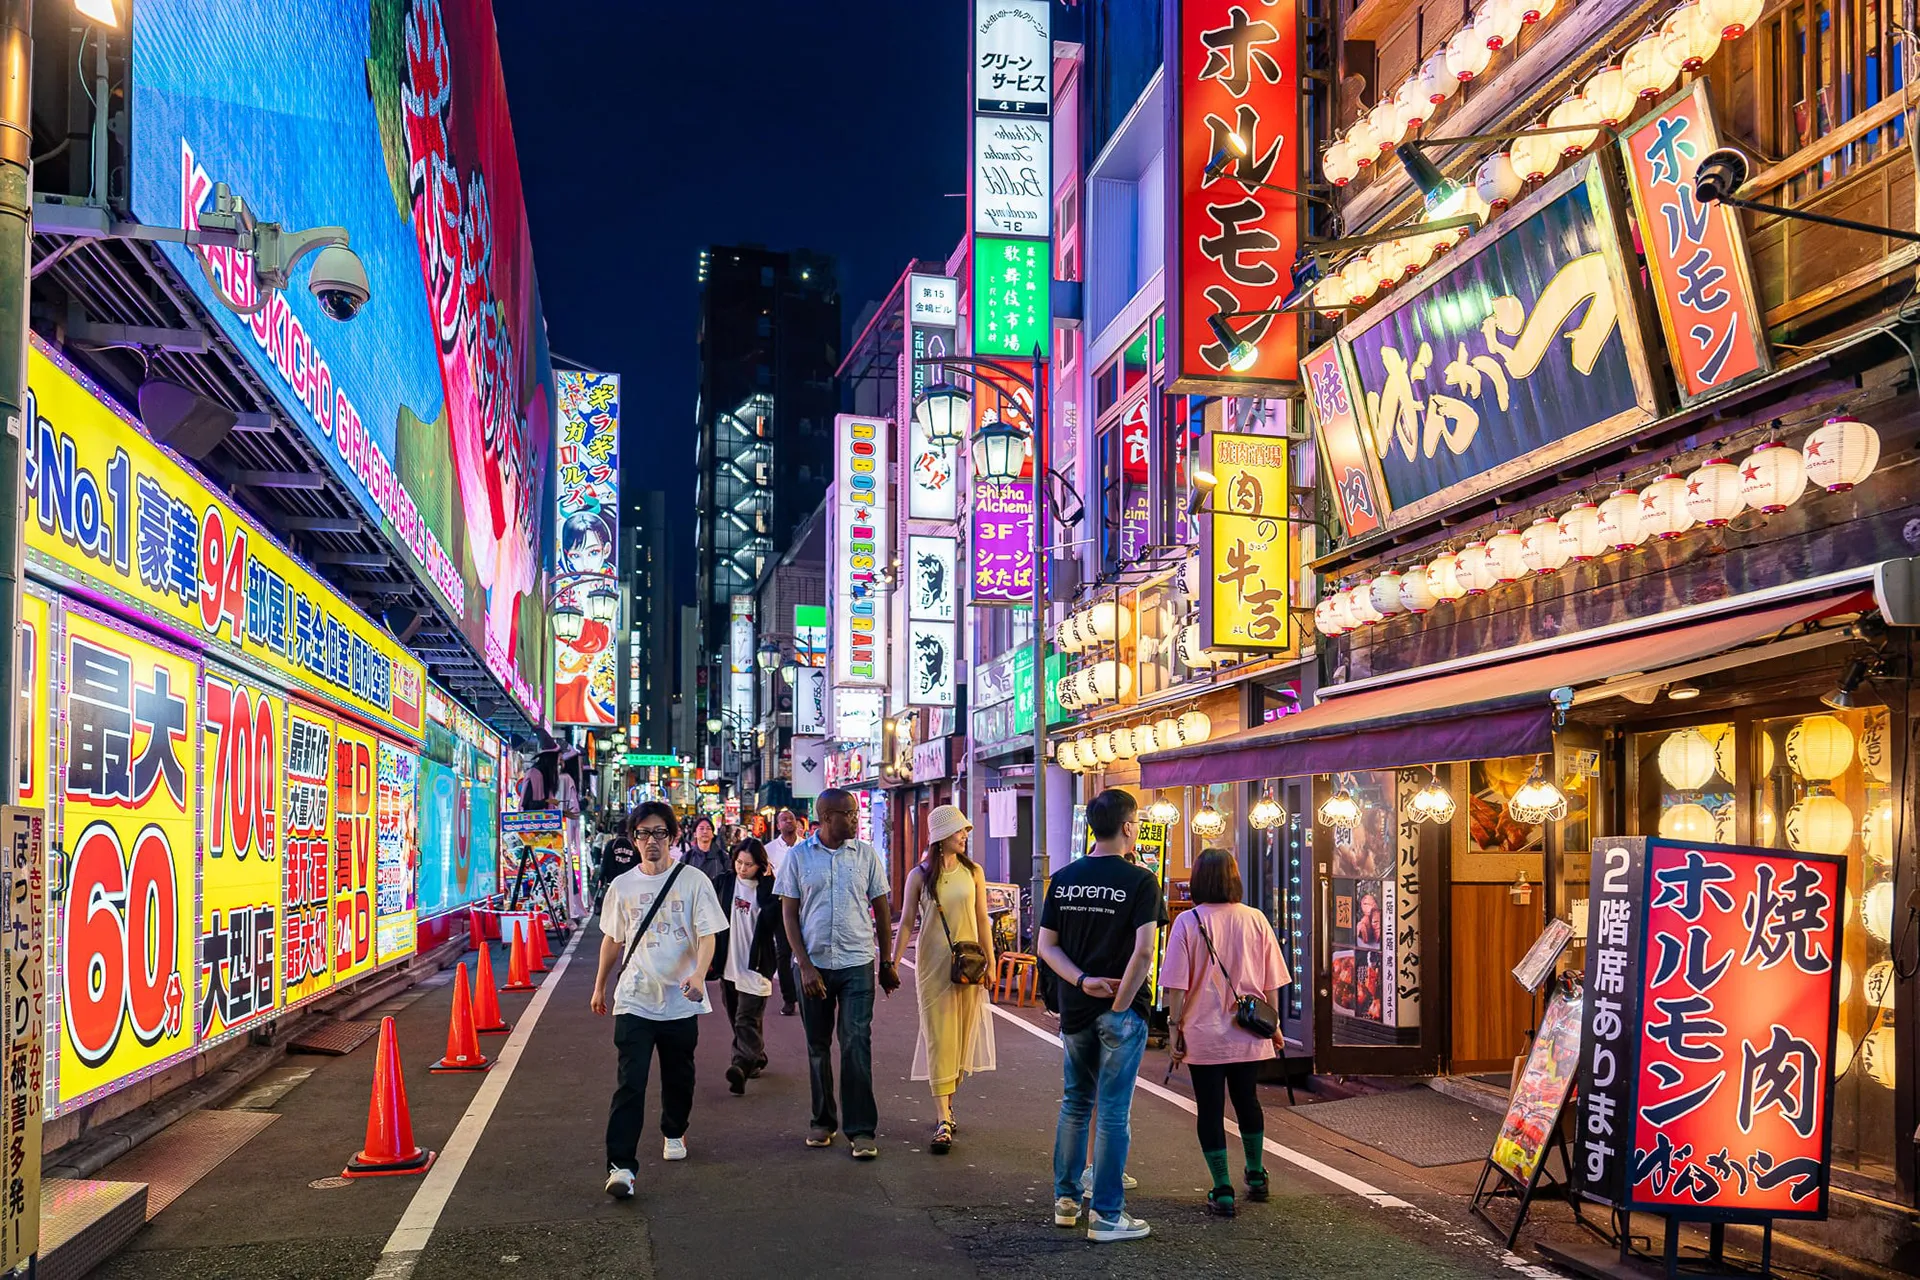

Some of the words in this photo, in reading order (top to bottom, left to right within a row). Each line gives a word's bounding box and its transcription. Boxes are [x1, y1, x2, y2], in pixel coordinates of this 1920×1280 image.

[981, 53, 1033, 71] クリーン
[992, 73, 1046, 92] サービス
[1199, 7, 1283, 371] ホルモン
[1644, 115, 1738, 386] ホルモン
[923, 288, 945, 298] 第15
[1003, 245, 1021, 352] 歌舞伎市場
[564, 421, 588, 507] ガールズ
[588, 384, 616, 486] ギラギラ
[850, 423, 876, 507] ROBOT
[1218, 440, 1283, 468] 焼肉酒場
[1312, 361, 1376, 526] 焼肉
[976, 485, 1024, 500] Shisha
[980, 523, 1014, 540] 3F
[976, 567, 1047, 587] 水たば
[977, 548, 1047, 568] シーシ
[940, 605, 951, 616] 1F
[66, 634, 187, 814] 最大
[940, 692, 951, 701] B1
[288, 716, 330, 783] 最新作
[287, 837, 329, 911] 新宿
[355, 741, 371, 965] DVD
[1054, 885, 1127, 902] supreme
[29, 815, 42, 1117] 客引きにはついていかない
[202, 902, 276, 1043] 大型店
[1640, 850, 1735, 1129] ホルモン
[1738, 863, 1833, 1139] 焼肉
[1585, 847, 1630, 1183] 2階席あります
